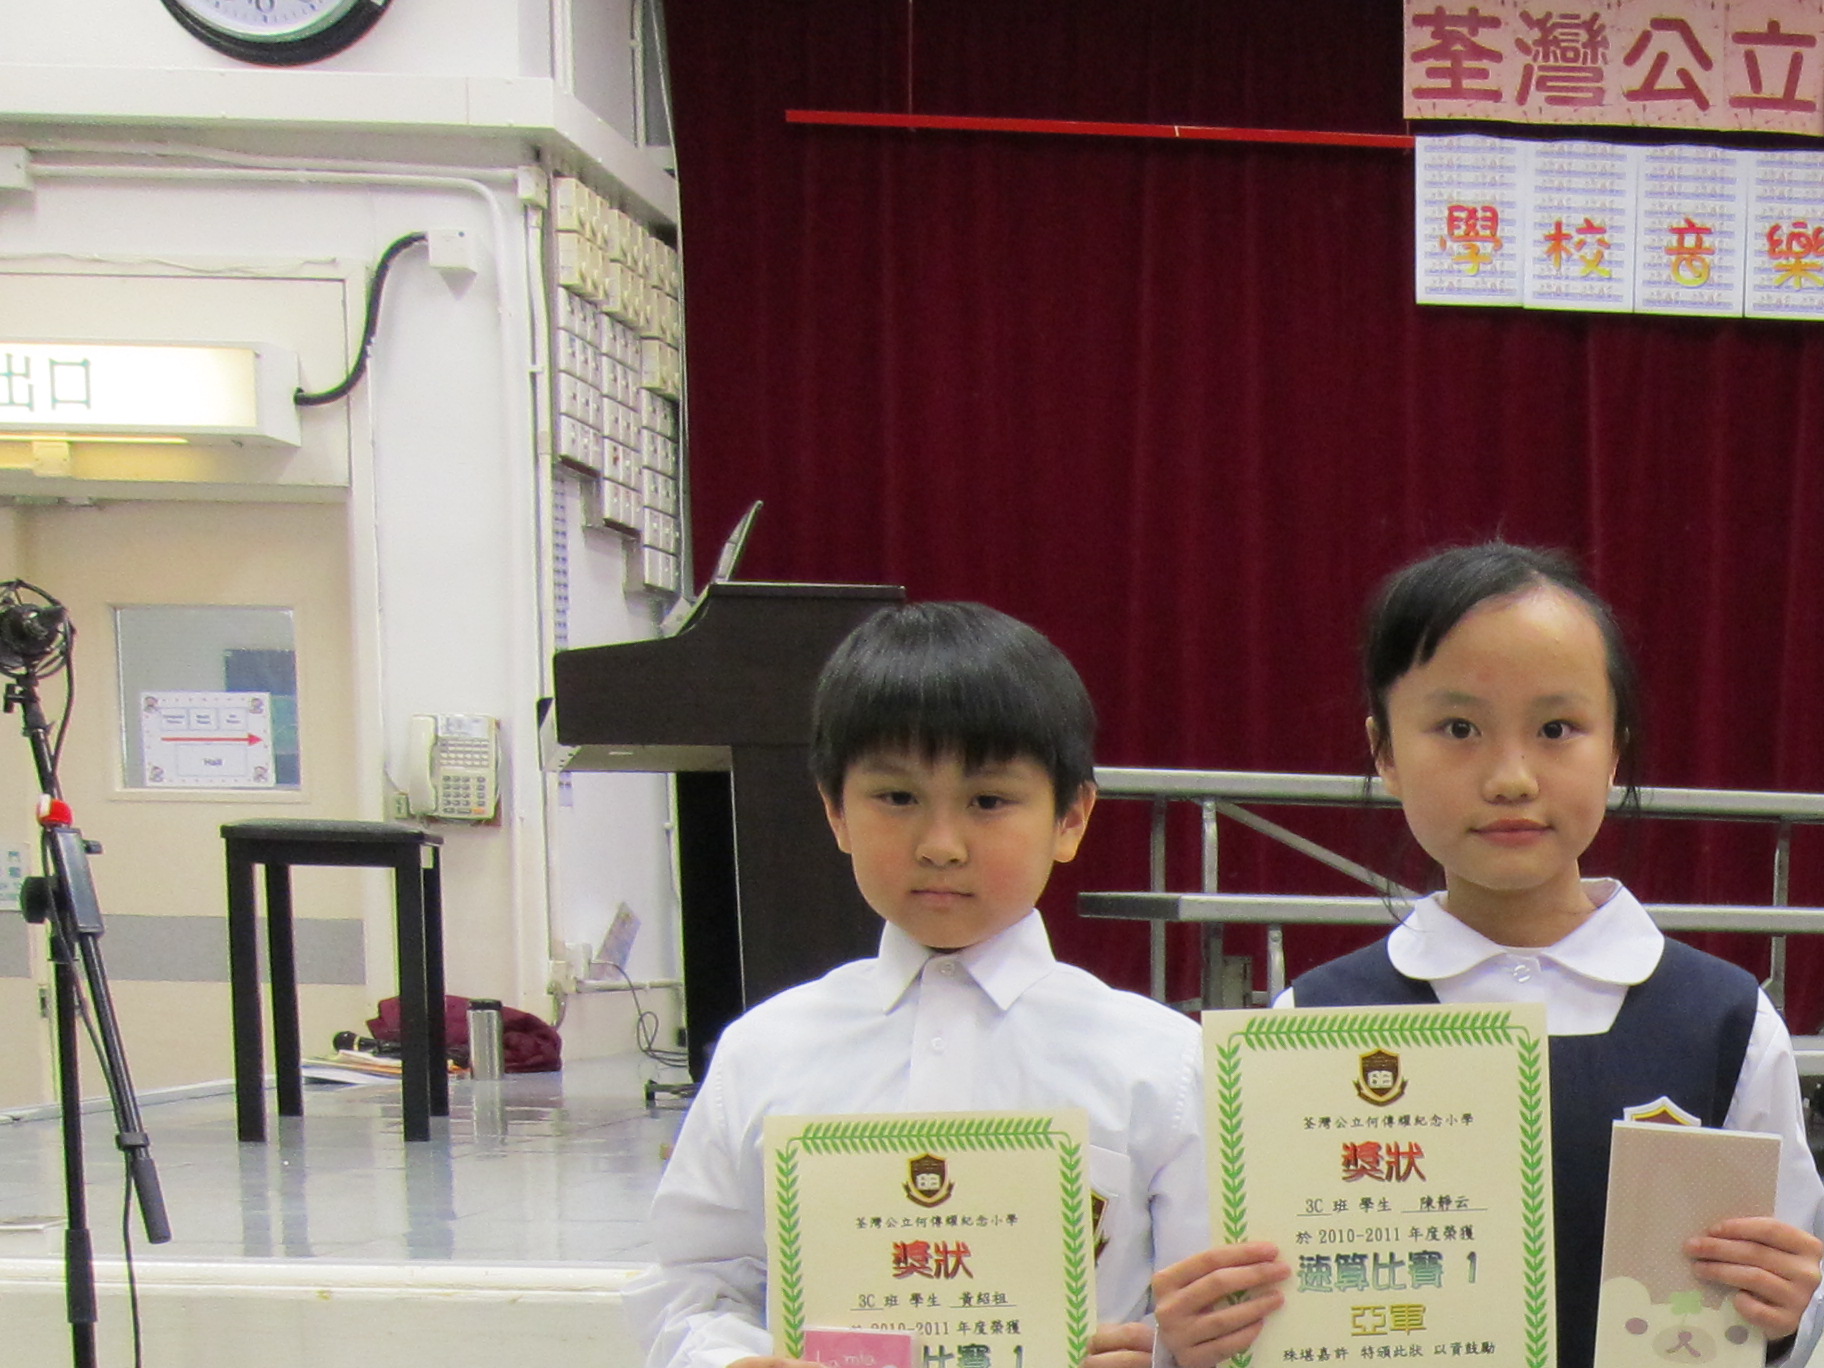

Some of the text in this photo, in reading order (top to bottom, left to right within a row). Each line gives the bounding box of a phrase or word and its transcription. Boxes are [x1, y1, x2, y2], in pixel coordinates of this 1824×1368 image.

[0, 353, 91, 412] 出口
[1303, 1113, 1474, 1130] 荃灣公立何傳耀紀念小學
[1342, 1140, 1427, 1183] 獎狀
[1305, 1199, 1324, 1213] 3C
[1332, 1198, 1350, 1213] 班
[1359, 1197, 1392, 1213] 學生
[856, 1213, 1019, 1230] 荃灣公立何傳耀紀念小學
[1295, 1225, 1475, 1245] 於 2010-2011 年度榮獲
[891, 1239, 974, 1280] 獎狀
[1296, 1250, 1477, 1292] 速算比賽 1
[858, 1293, 876, 1308] 3C
[883, 1294, 900, 1308] 班
[909, 1292, 941, 1308] 學生
[956, 1319, 1022, 1335] 年度榮獲
[1350, 1303, 1427, 1337] 亞軍
